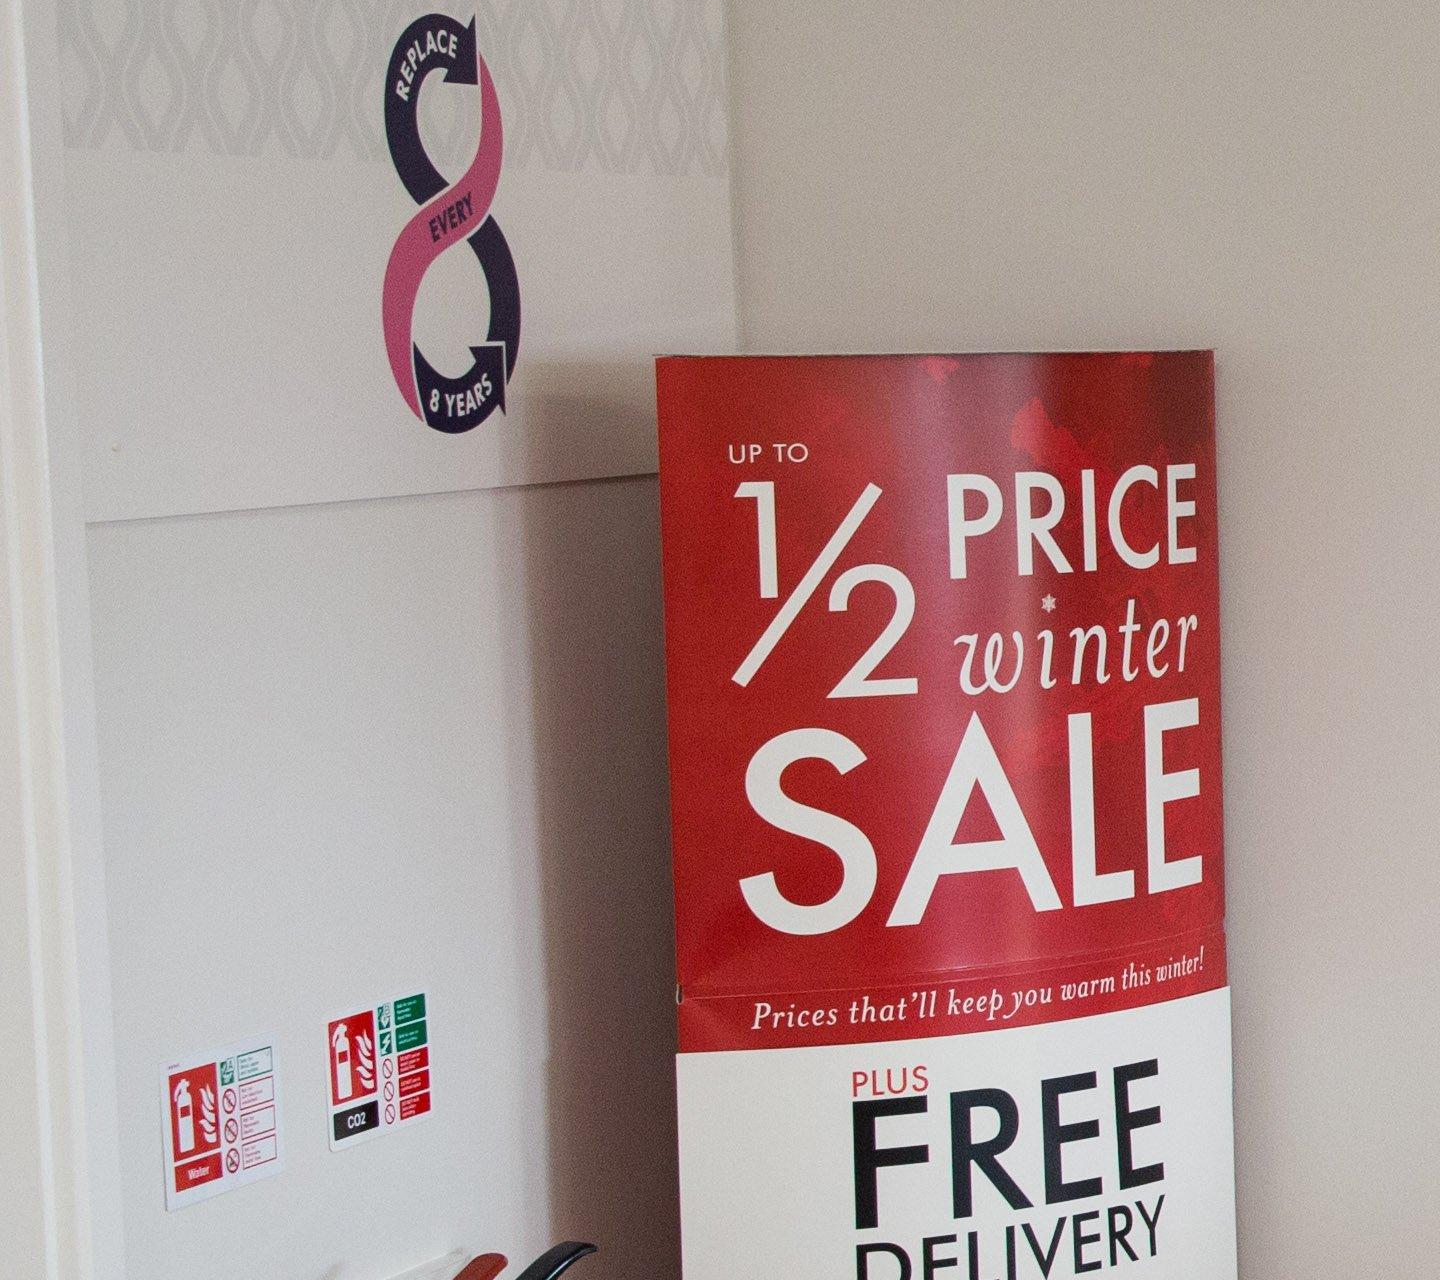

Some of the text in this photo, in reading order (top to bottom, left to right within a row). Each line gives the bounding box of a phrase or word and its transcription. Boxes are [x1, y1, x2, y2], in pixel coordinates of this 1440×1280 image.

[395, 28, 460, 102] REPLACE
[428, 191, 477, 244] EVERY
[429, 375, 494, 420] 8 YEARS
[728, 442, 809, 465] UP TO
[945, 462, 1199, 579] PRICE
[953, 596, 1200, 697] winter
[738, 697, 1203, 936] SALE
[751, 947, 1206, 1032] Prices that'll keep you warm this winter!
[852, 1065, 930, 1097] PLUS
[347, 1111, 367, 1130] CO2
[852, 1058, 1166, 1231] FREE
[187, 1166, 211, 1181] Water
